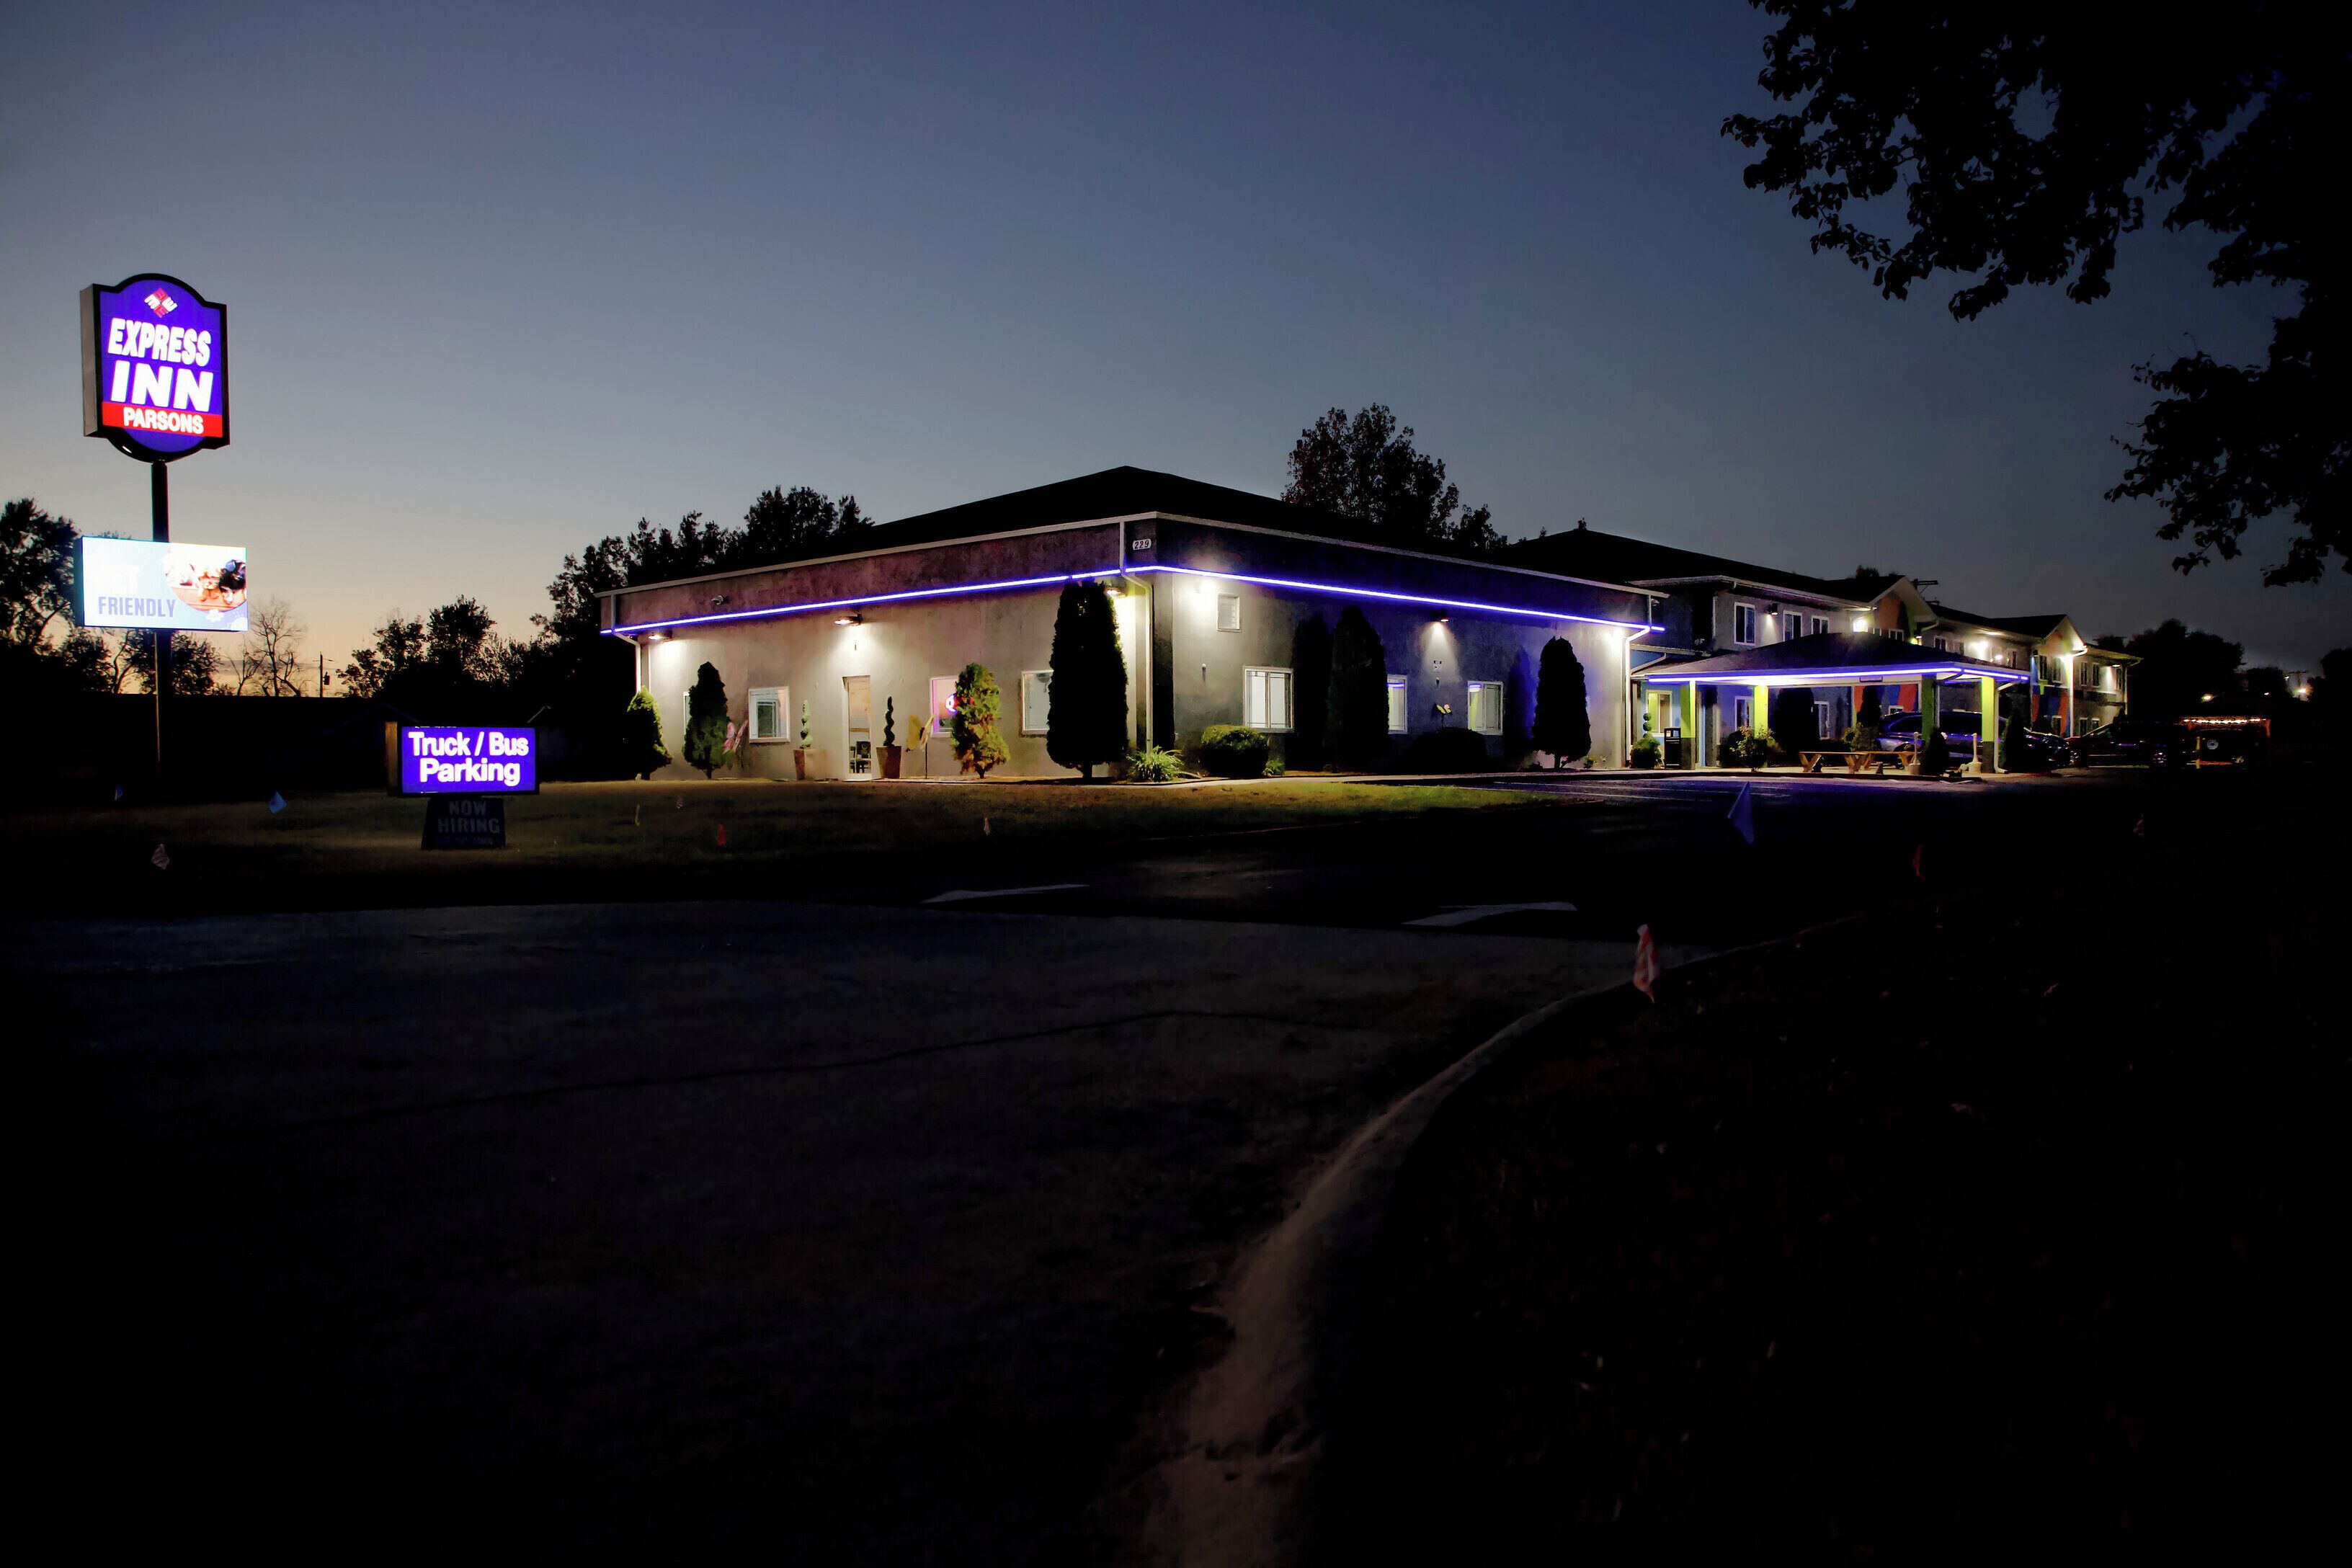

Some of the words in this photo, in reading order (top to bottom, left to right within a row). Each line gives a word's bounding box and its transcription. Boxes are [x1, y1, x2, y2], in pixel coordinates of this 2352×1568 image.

[108, 317, 211, 367] EXPRESS
[110, 360, 214, 412] INN
[122, 406, 204, 435] PARSONS
[1134, 540, 1150, 549] 229
[98, 596, 176, 618] FRIENDLY
[408, 731, 471, 756] Truck
[489, 731, 529, 756] Bus
[419, 757, 520, 786] Parking
[449, 800, 487, 815] NOW
[437, 817, 500, 834] HIRING
